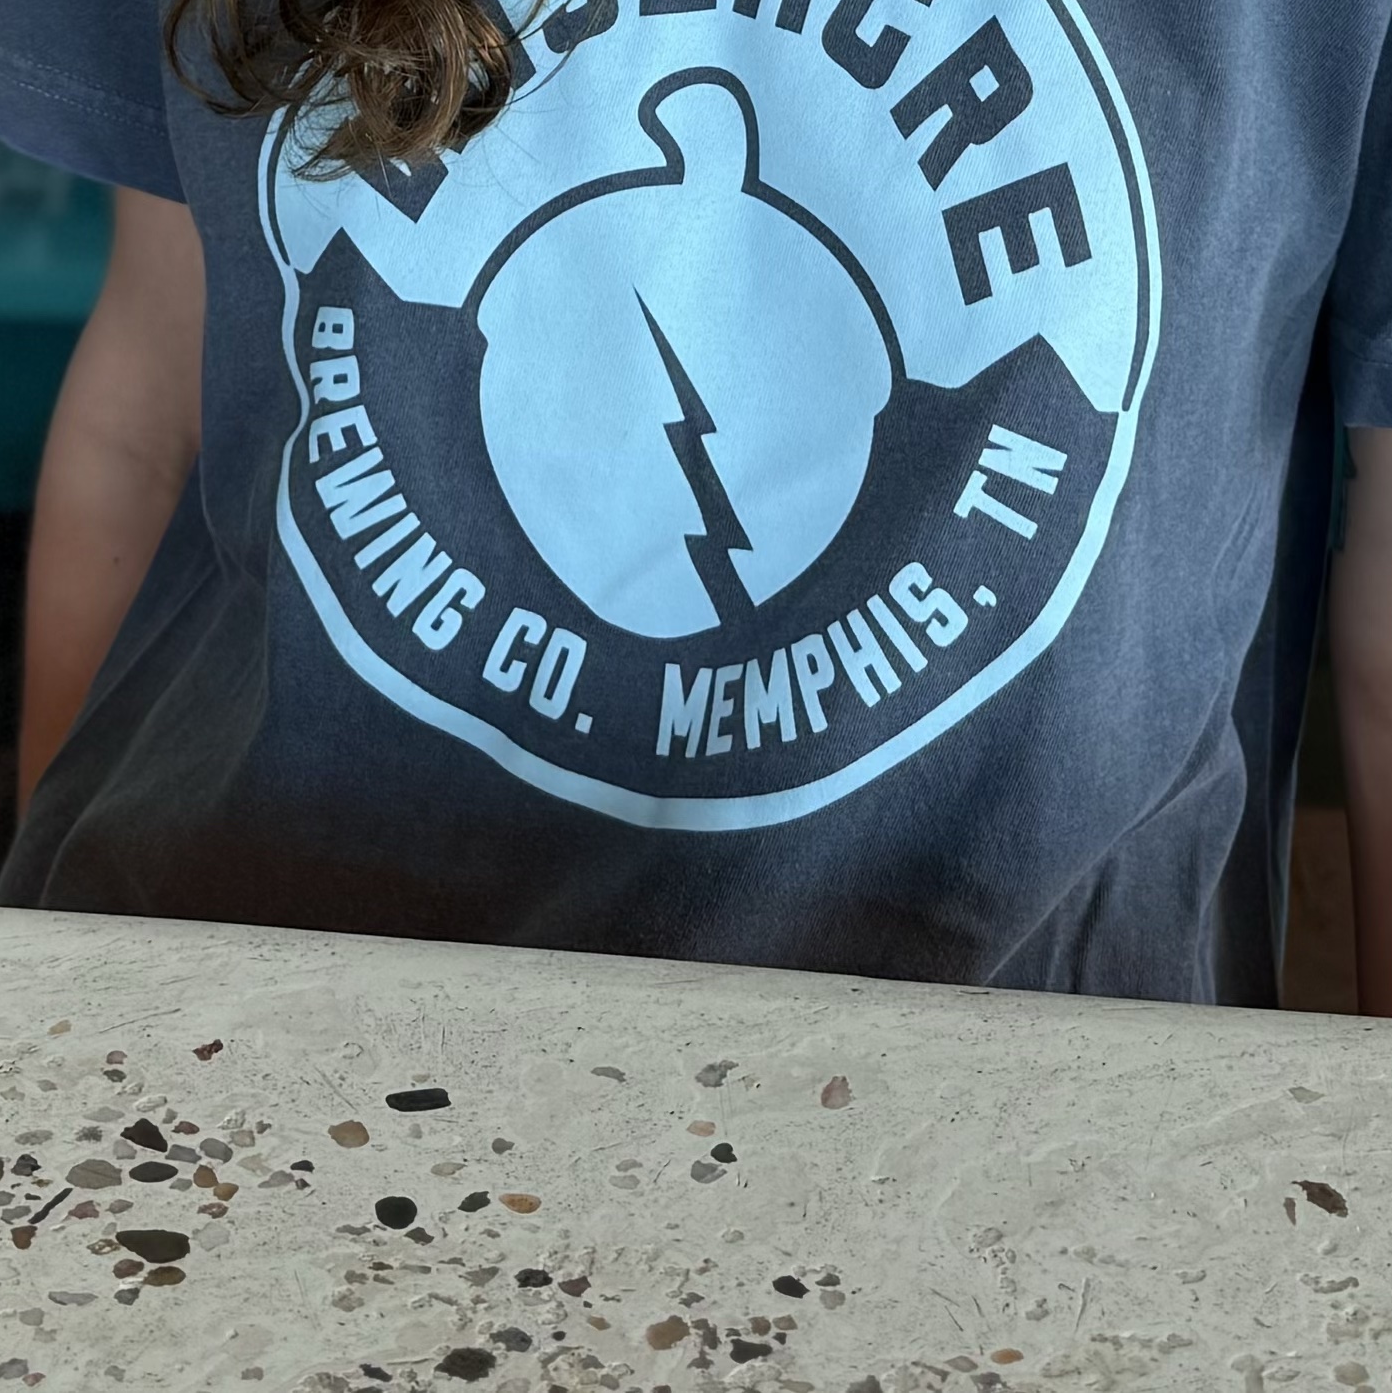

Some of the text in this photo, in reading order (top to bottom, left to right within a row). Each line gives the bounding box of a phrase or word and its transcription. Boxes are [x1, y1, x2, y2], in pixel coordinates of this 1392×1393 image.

[305, 305, 1068, 758] BREWING CO. MEMPHIS, TN
